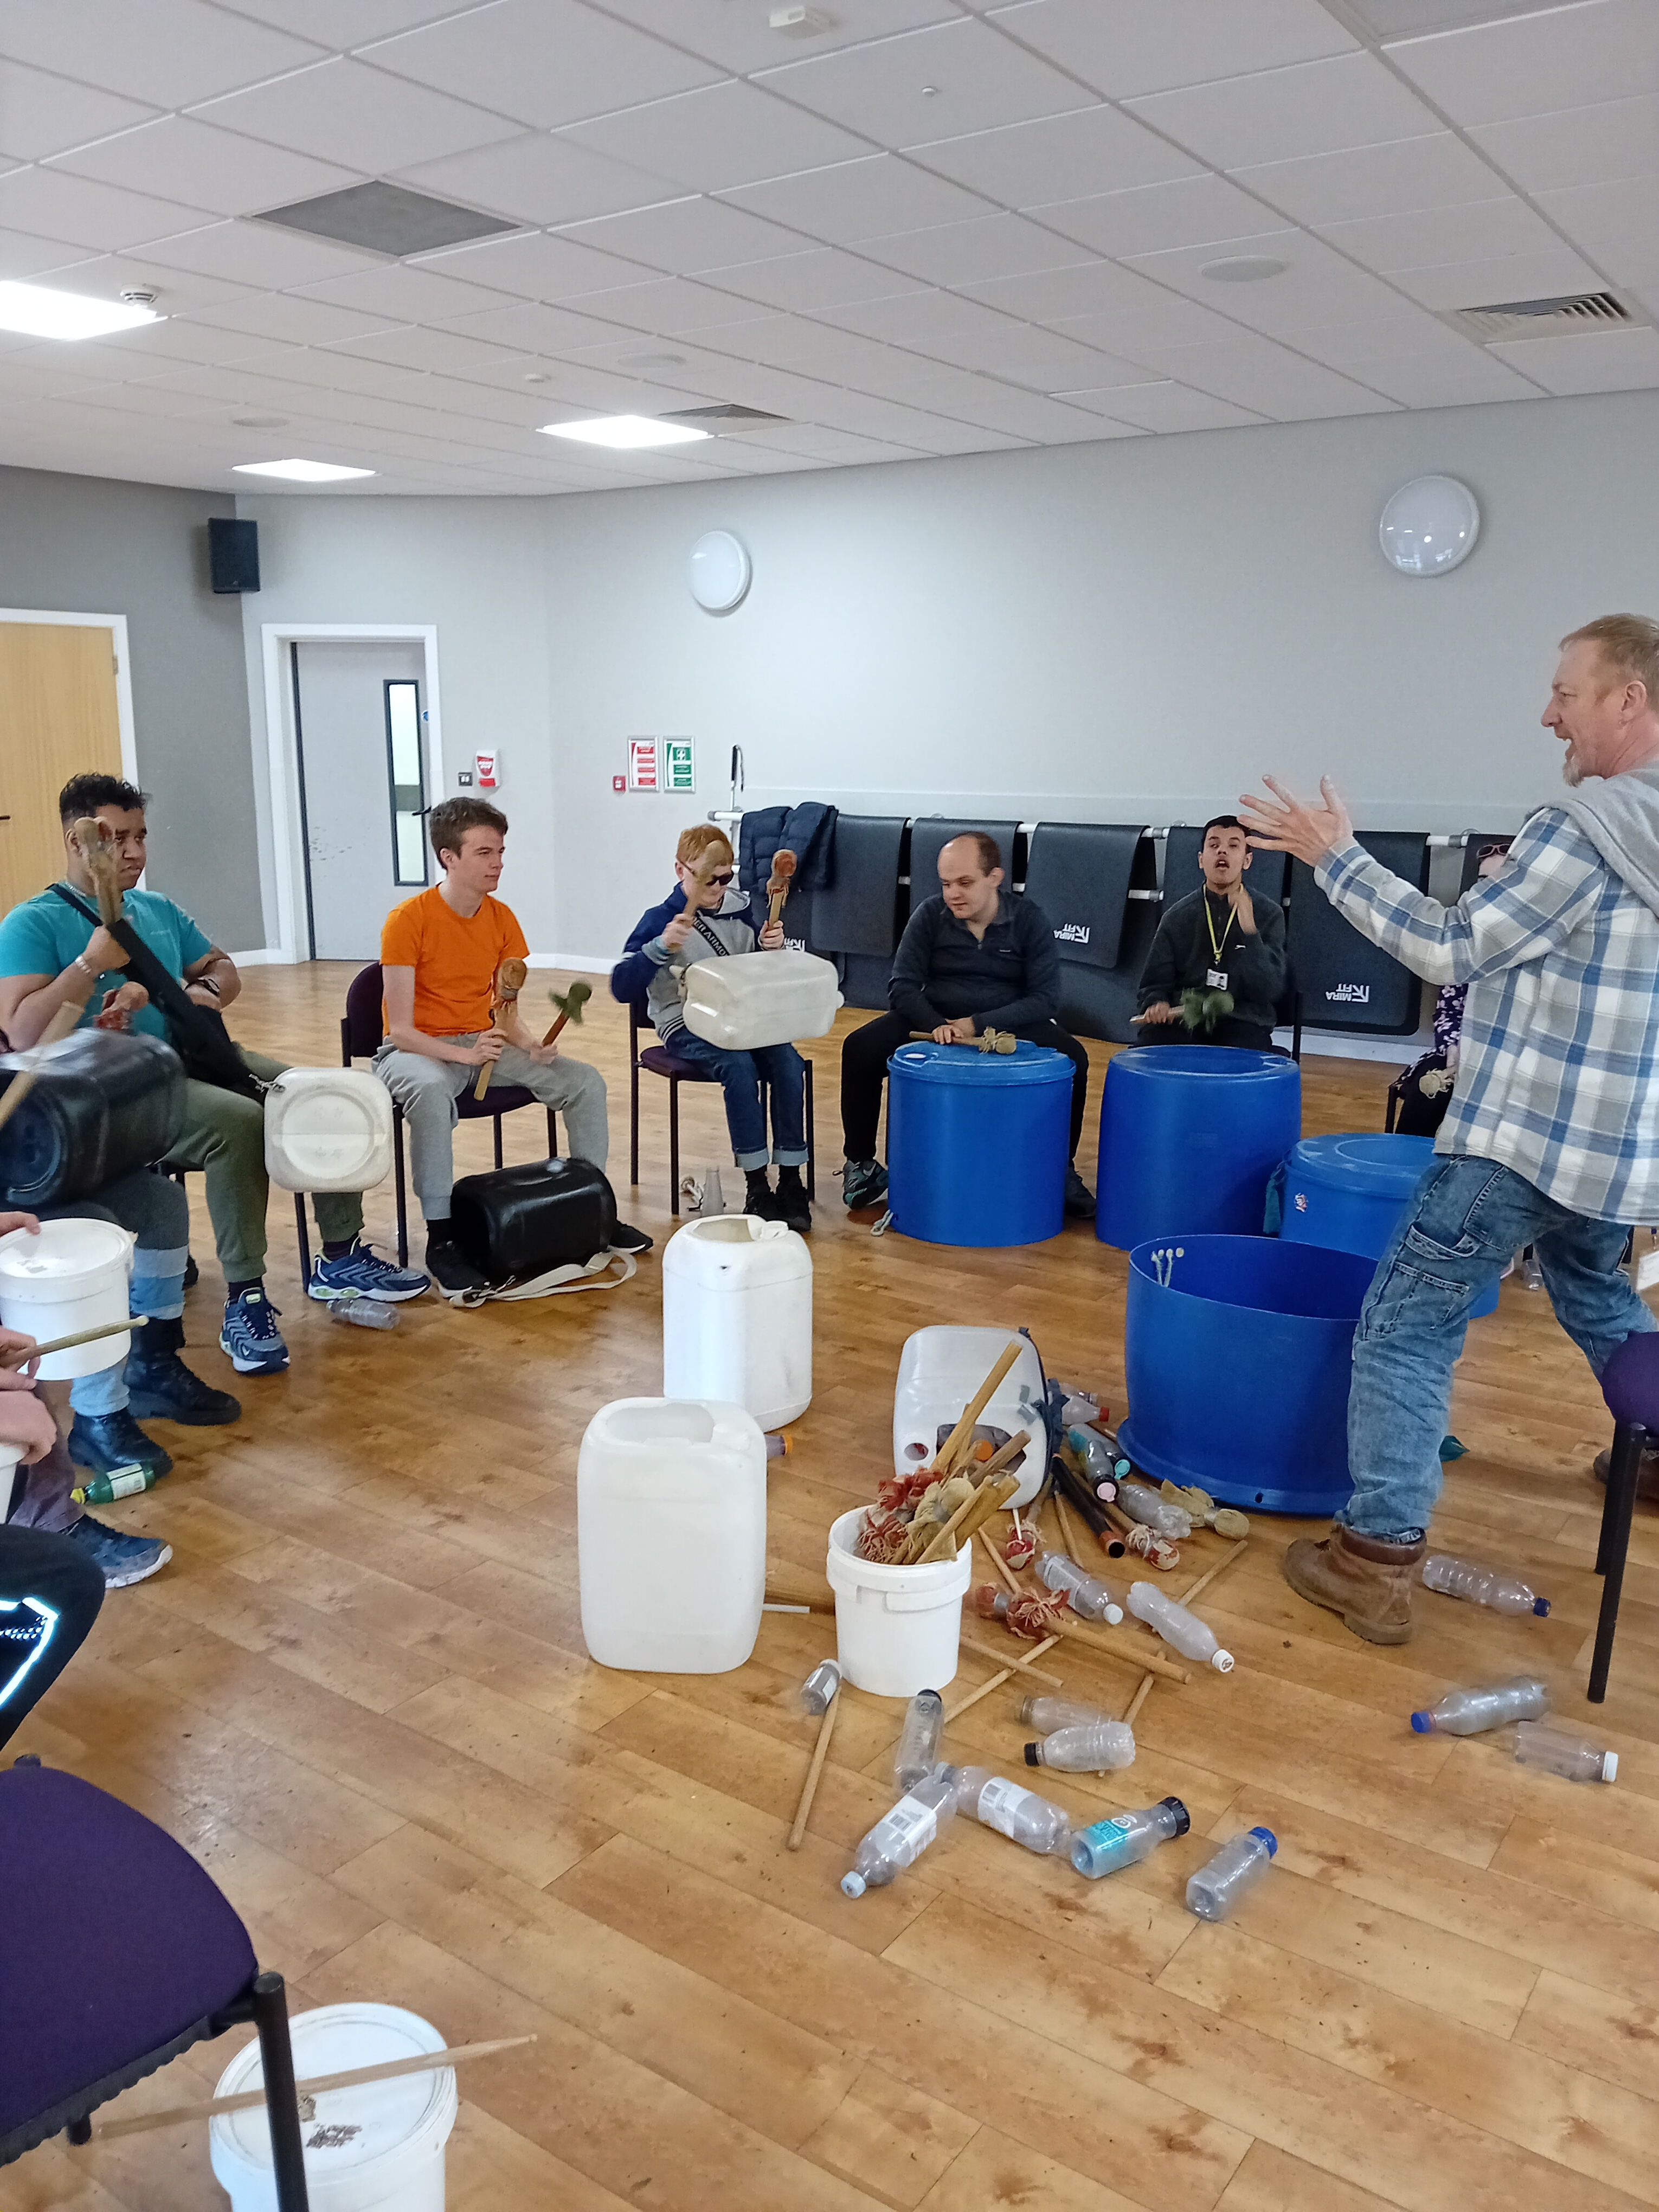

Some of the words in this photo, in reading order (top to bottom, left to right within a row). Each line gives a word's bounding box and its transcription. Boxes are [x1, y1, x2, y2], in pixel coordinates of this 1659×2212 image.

[1062, 923, 1077, 933] FIT
[1053, 929, 1075, 941] MIRA
[704, 931, 727, 956] ARMO
[1335, 983, 1352, 992] FIT
[1325, 991, 1352, 1001] MIRA
